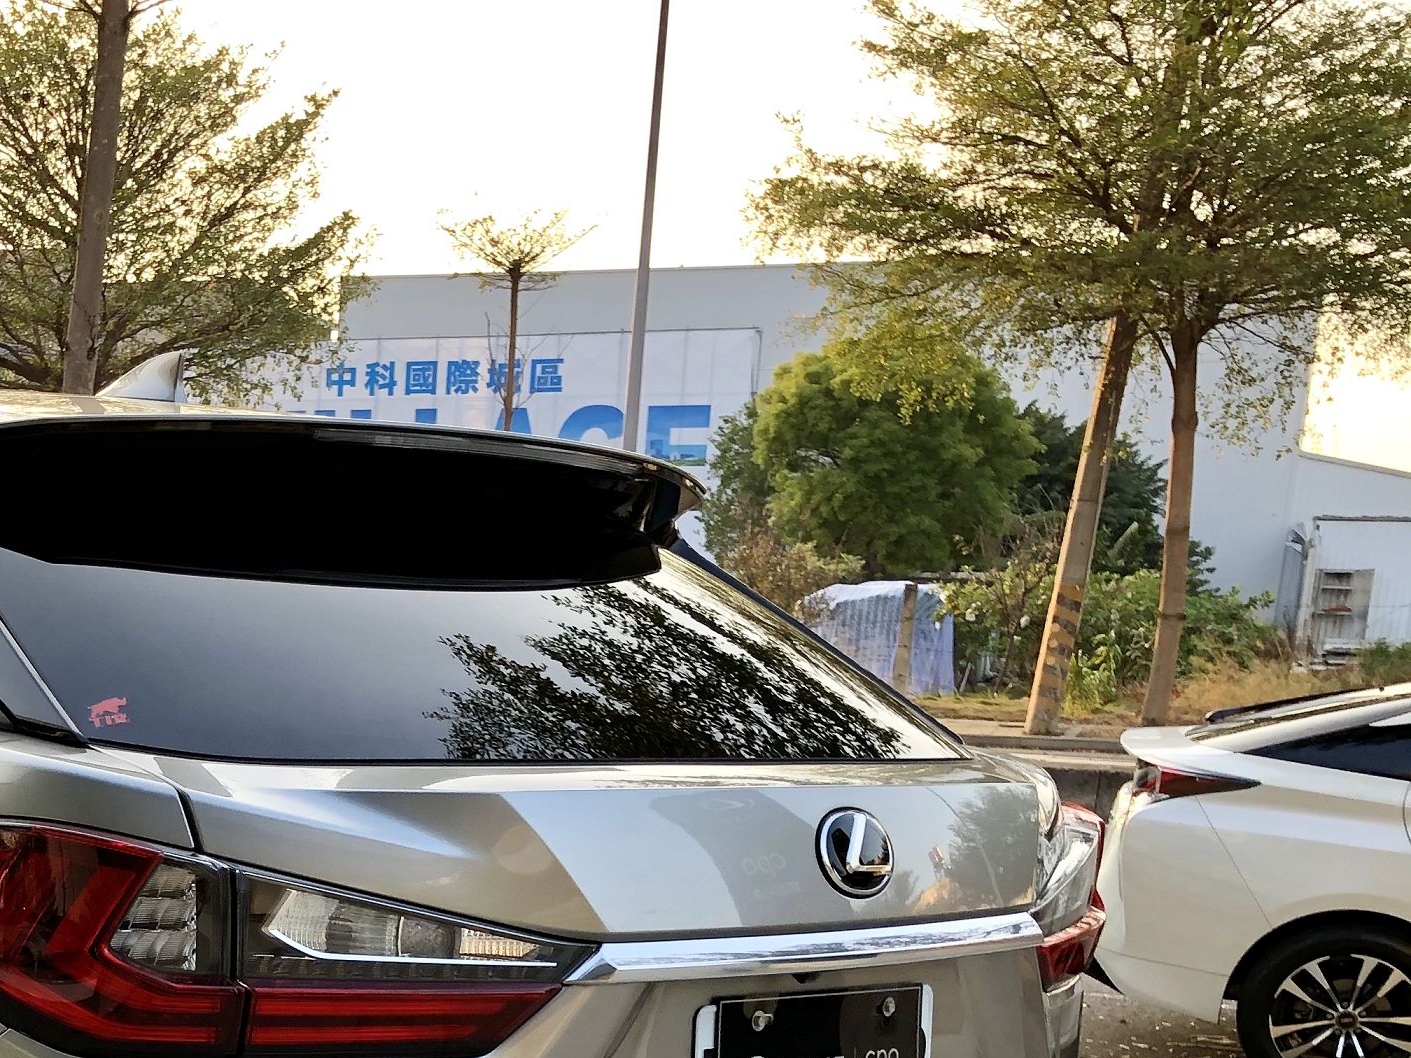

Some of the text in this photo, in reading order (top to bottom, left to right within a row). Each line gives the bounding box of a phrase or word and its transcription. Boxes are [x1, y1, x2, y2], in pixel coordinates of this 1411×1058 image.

[326, 358, 565, 397] 中科國際城區
